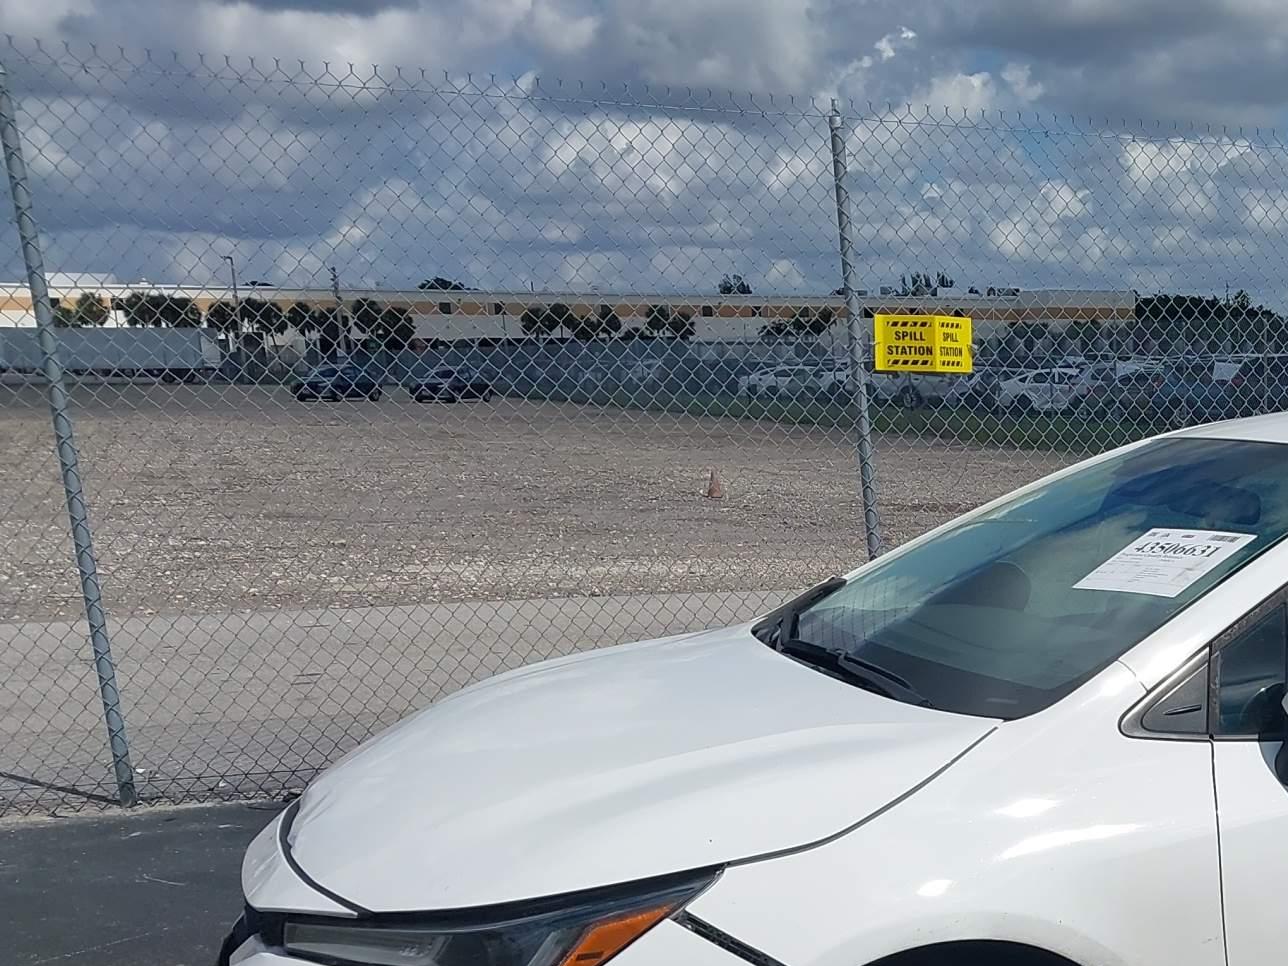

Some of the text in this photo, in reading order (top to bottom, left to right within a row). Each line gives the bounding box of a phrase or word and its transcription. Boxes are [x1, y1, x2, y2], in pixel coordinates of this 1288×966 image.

[894, 330, 926, 341] SPILL
[942, 332, 959, 342] SPILL
[887, 345, 933, 356] STATION
[939, 346, 963, 357] STATION
[1134, 541, 1221, 558] 43506631
